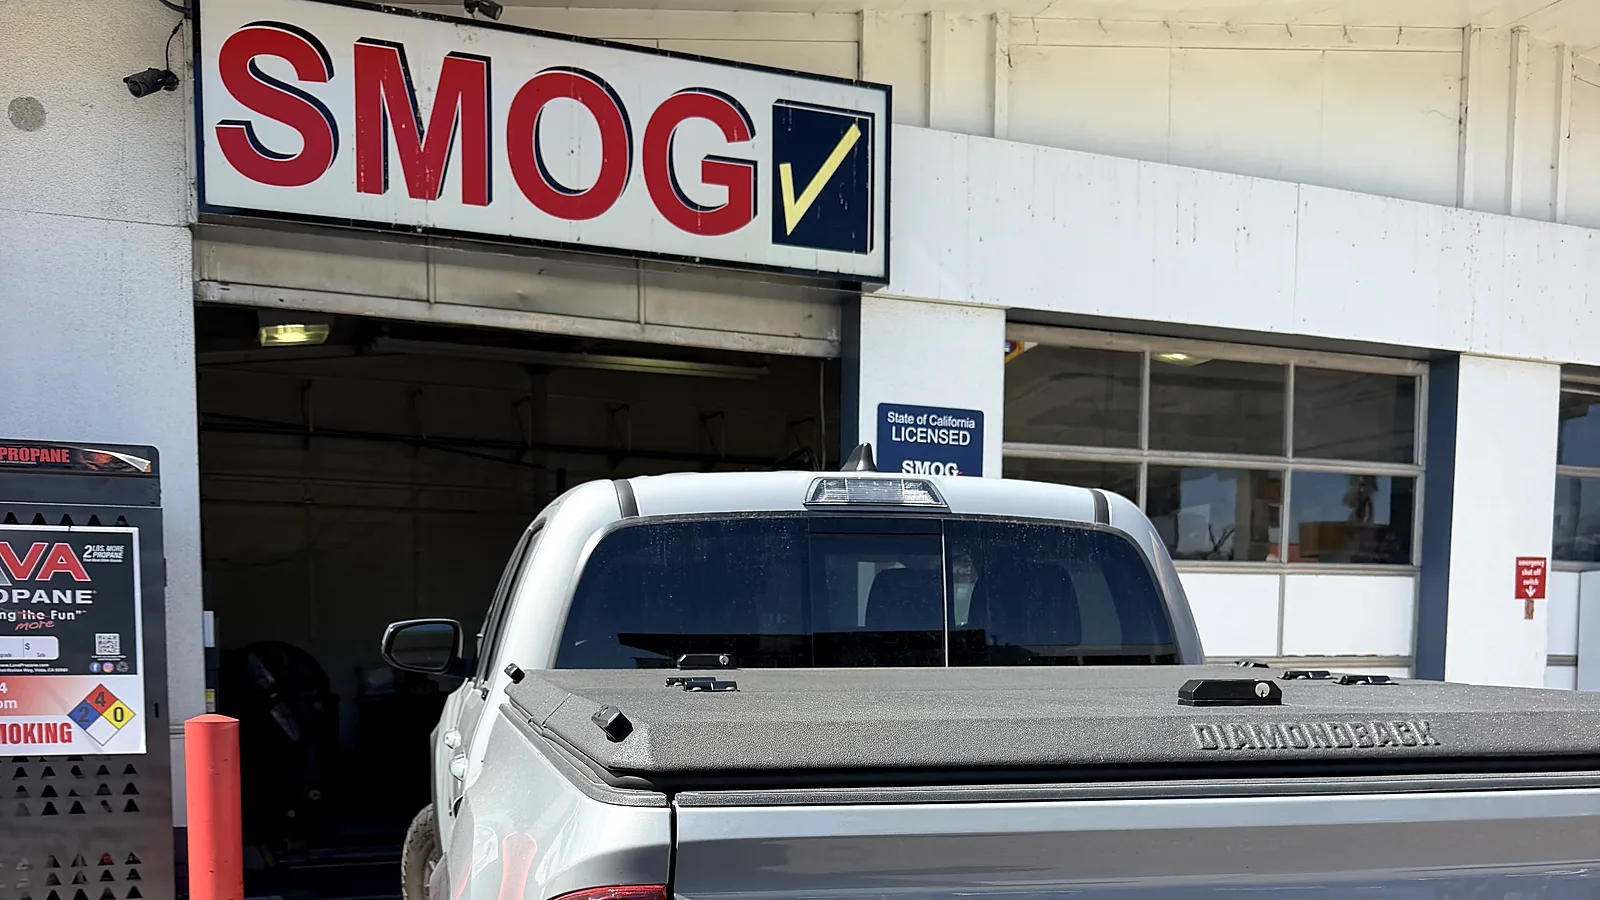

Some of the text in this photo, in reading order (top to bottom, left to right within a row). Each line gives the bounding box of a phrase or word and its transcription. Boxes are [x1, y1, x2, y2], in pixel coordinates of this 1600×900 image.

[214, 20, 759, 236] SMOG
[887, 411, 976, 429] State of California
[891, 426, 971, 446] LICENSED
[0, 447, 70, 463] PROPANE
[83, 544, 92, 558] 2
[15, 620, 55, 631] more
[24, 642, 31, 651] $
[94, 692, 107, 707] 4
[79, 706, 90, 723] 2
[113, 706, 125, 723] 0
[1191, 720, 1441, 751] DIAMONDBACK
